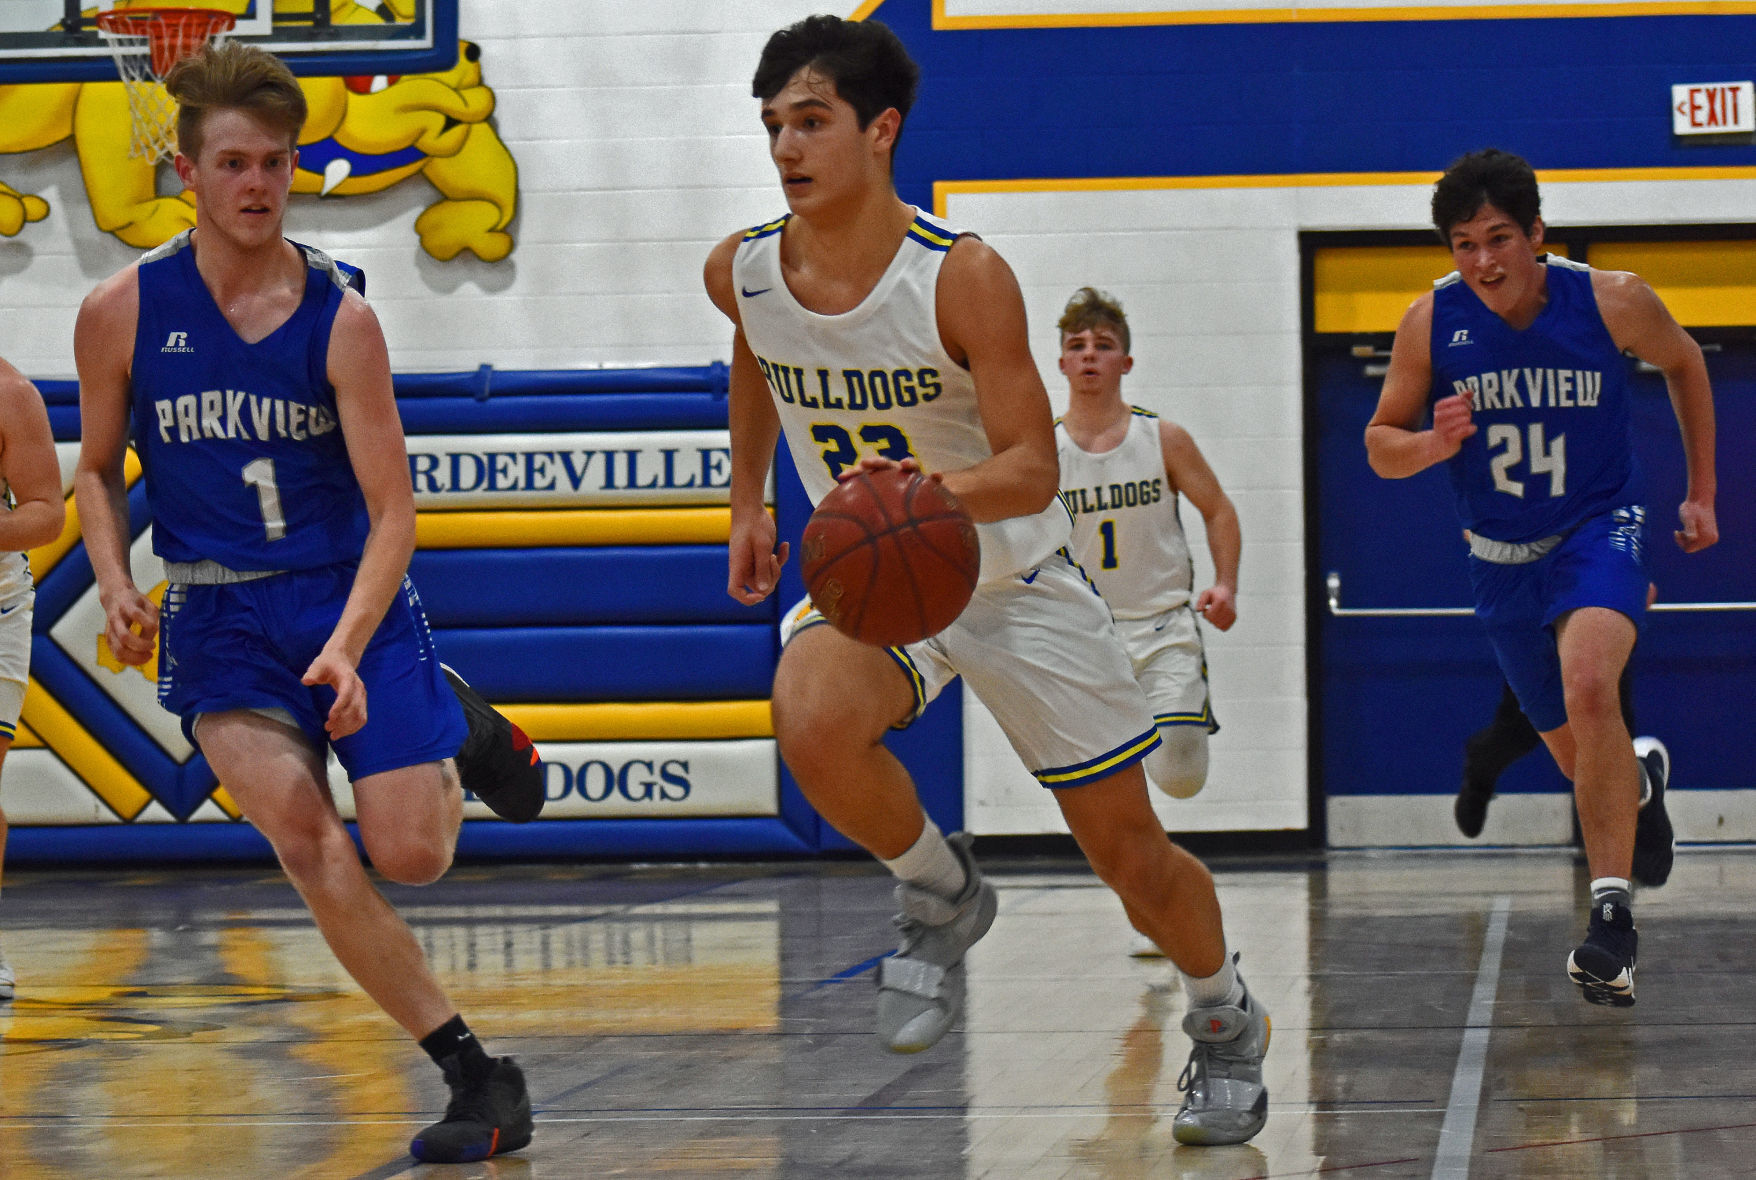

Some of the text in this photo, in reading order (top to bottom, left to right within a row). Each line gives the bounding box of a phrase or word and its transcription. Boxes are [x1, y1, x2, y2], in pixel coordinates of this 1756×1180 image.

[1689, 86, 1740, 127] EXIT
[166, 331, 188, 346] R
[155, 389, 337, 444] PARKVIEW
[407, 448, 731, 493] RDEEVILLE
[1487, 422, 1566, 498] 24
[241, 457, 286, 542] 1
[1099, 519, 1119, 569] 1
